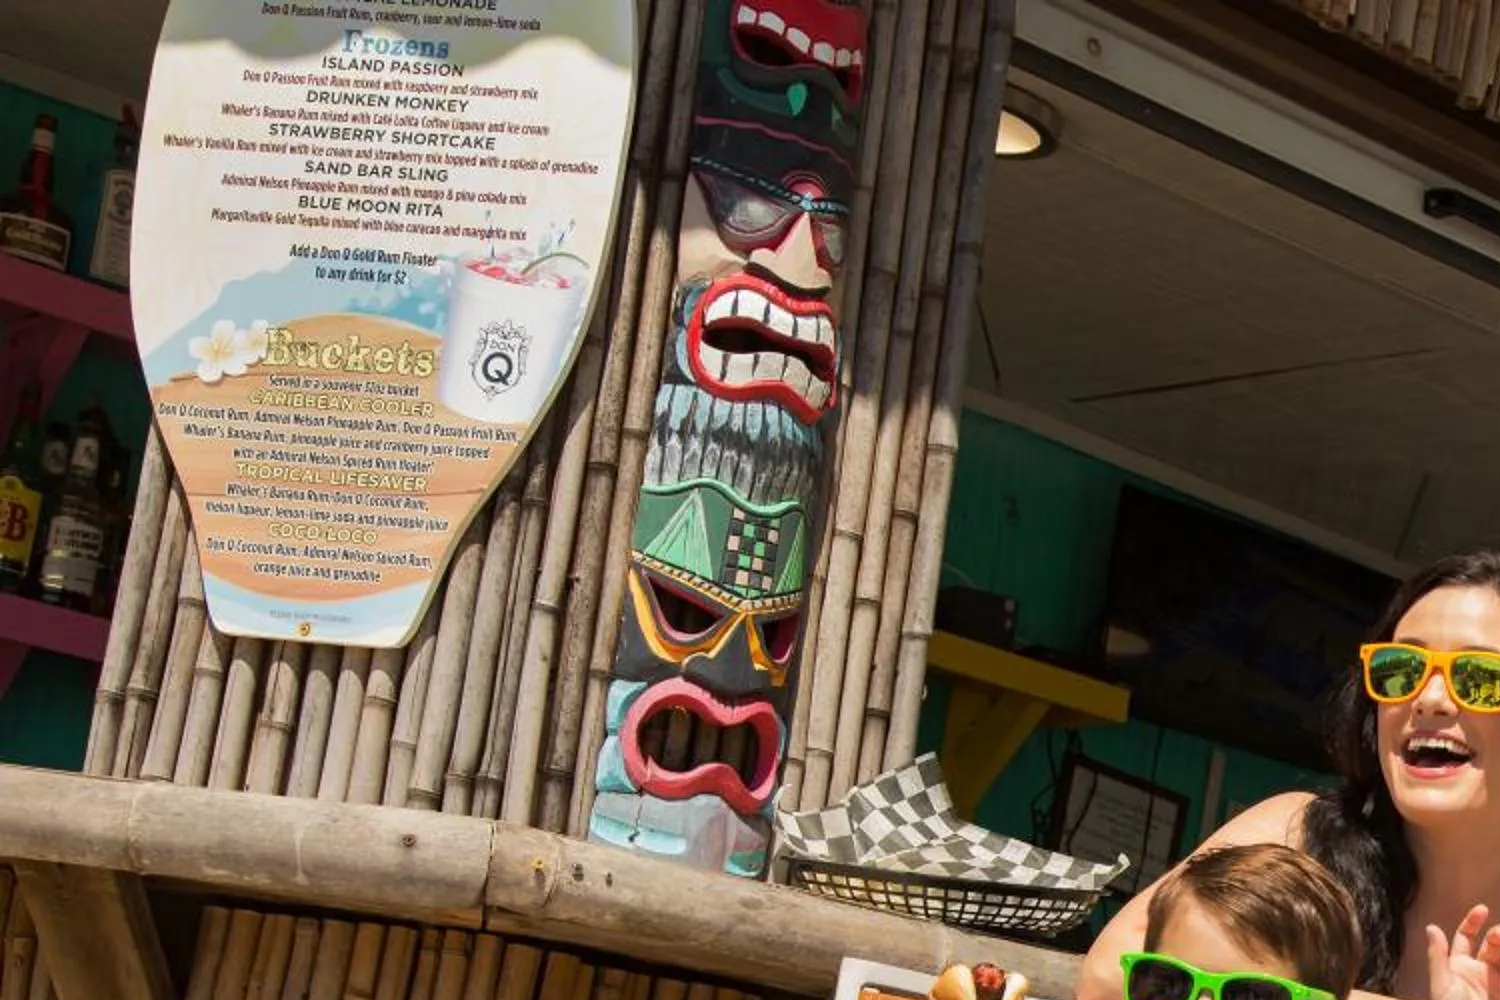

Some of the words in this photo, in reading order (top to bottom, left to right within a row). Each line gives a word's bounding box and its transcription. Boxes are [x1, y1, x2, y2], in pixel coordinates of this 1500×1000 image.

[341, 29, 449, 58] Frozens
[322, 56, 385, 72] ISLAND
[390, 60, 464, 77] PASSION
[306, 90, 389, 108] DRUNKEN
[395, 96, 469, 113] MONKEY
[269, 123, 386, 142] STRAWBERRY
[391, 131, 496, 151] SHORTCAKE
[305, 160, 352, 175] SAND
[357, 163, 393, 178] BAR
[397, 167, 448, 183] SLING
[299, 194, 342, 211] BLUE
[347, 199, 400, 214] MOON
[405, 202, 443, 217] RITA
[290, 244, 310, 258] Add
[312, 249, 318, 258] a
[321, 246, 340, 260] Don
[353, 249, 376, 263] Gold
[378, 251, 400, 264] Rum
[403, 253, 437, 268] Floater
[316, 266, 325, 278] to
[328, 270, 346, 283] any
[348, 268, 374, 281] drink
[378, 270, 392, 282] for
[262, 327, 435, 377] Buckets
[482, 352, 512, 386] Q
[250, 391, 355, 410] CARIBBEAN
[359, 397, 435, 417] COOLER
[236, 462, 324, 484] TROPICAL
[329, 470, 427, 492] LIFESAVER
[268, 522, 322, 539] COCO
[326, 526, 378, 544] LOCO
